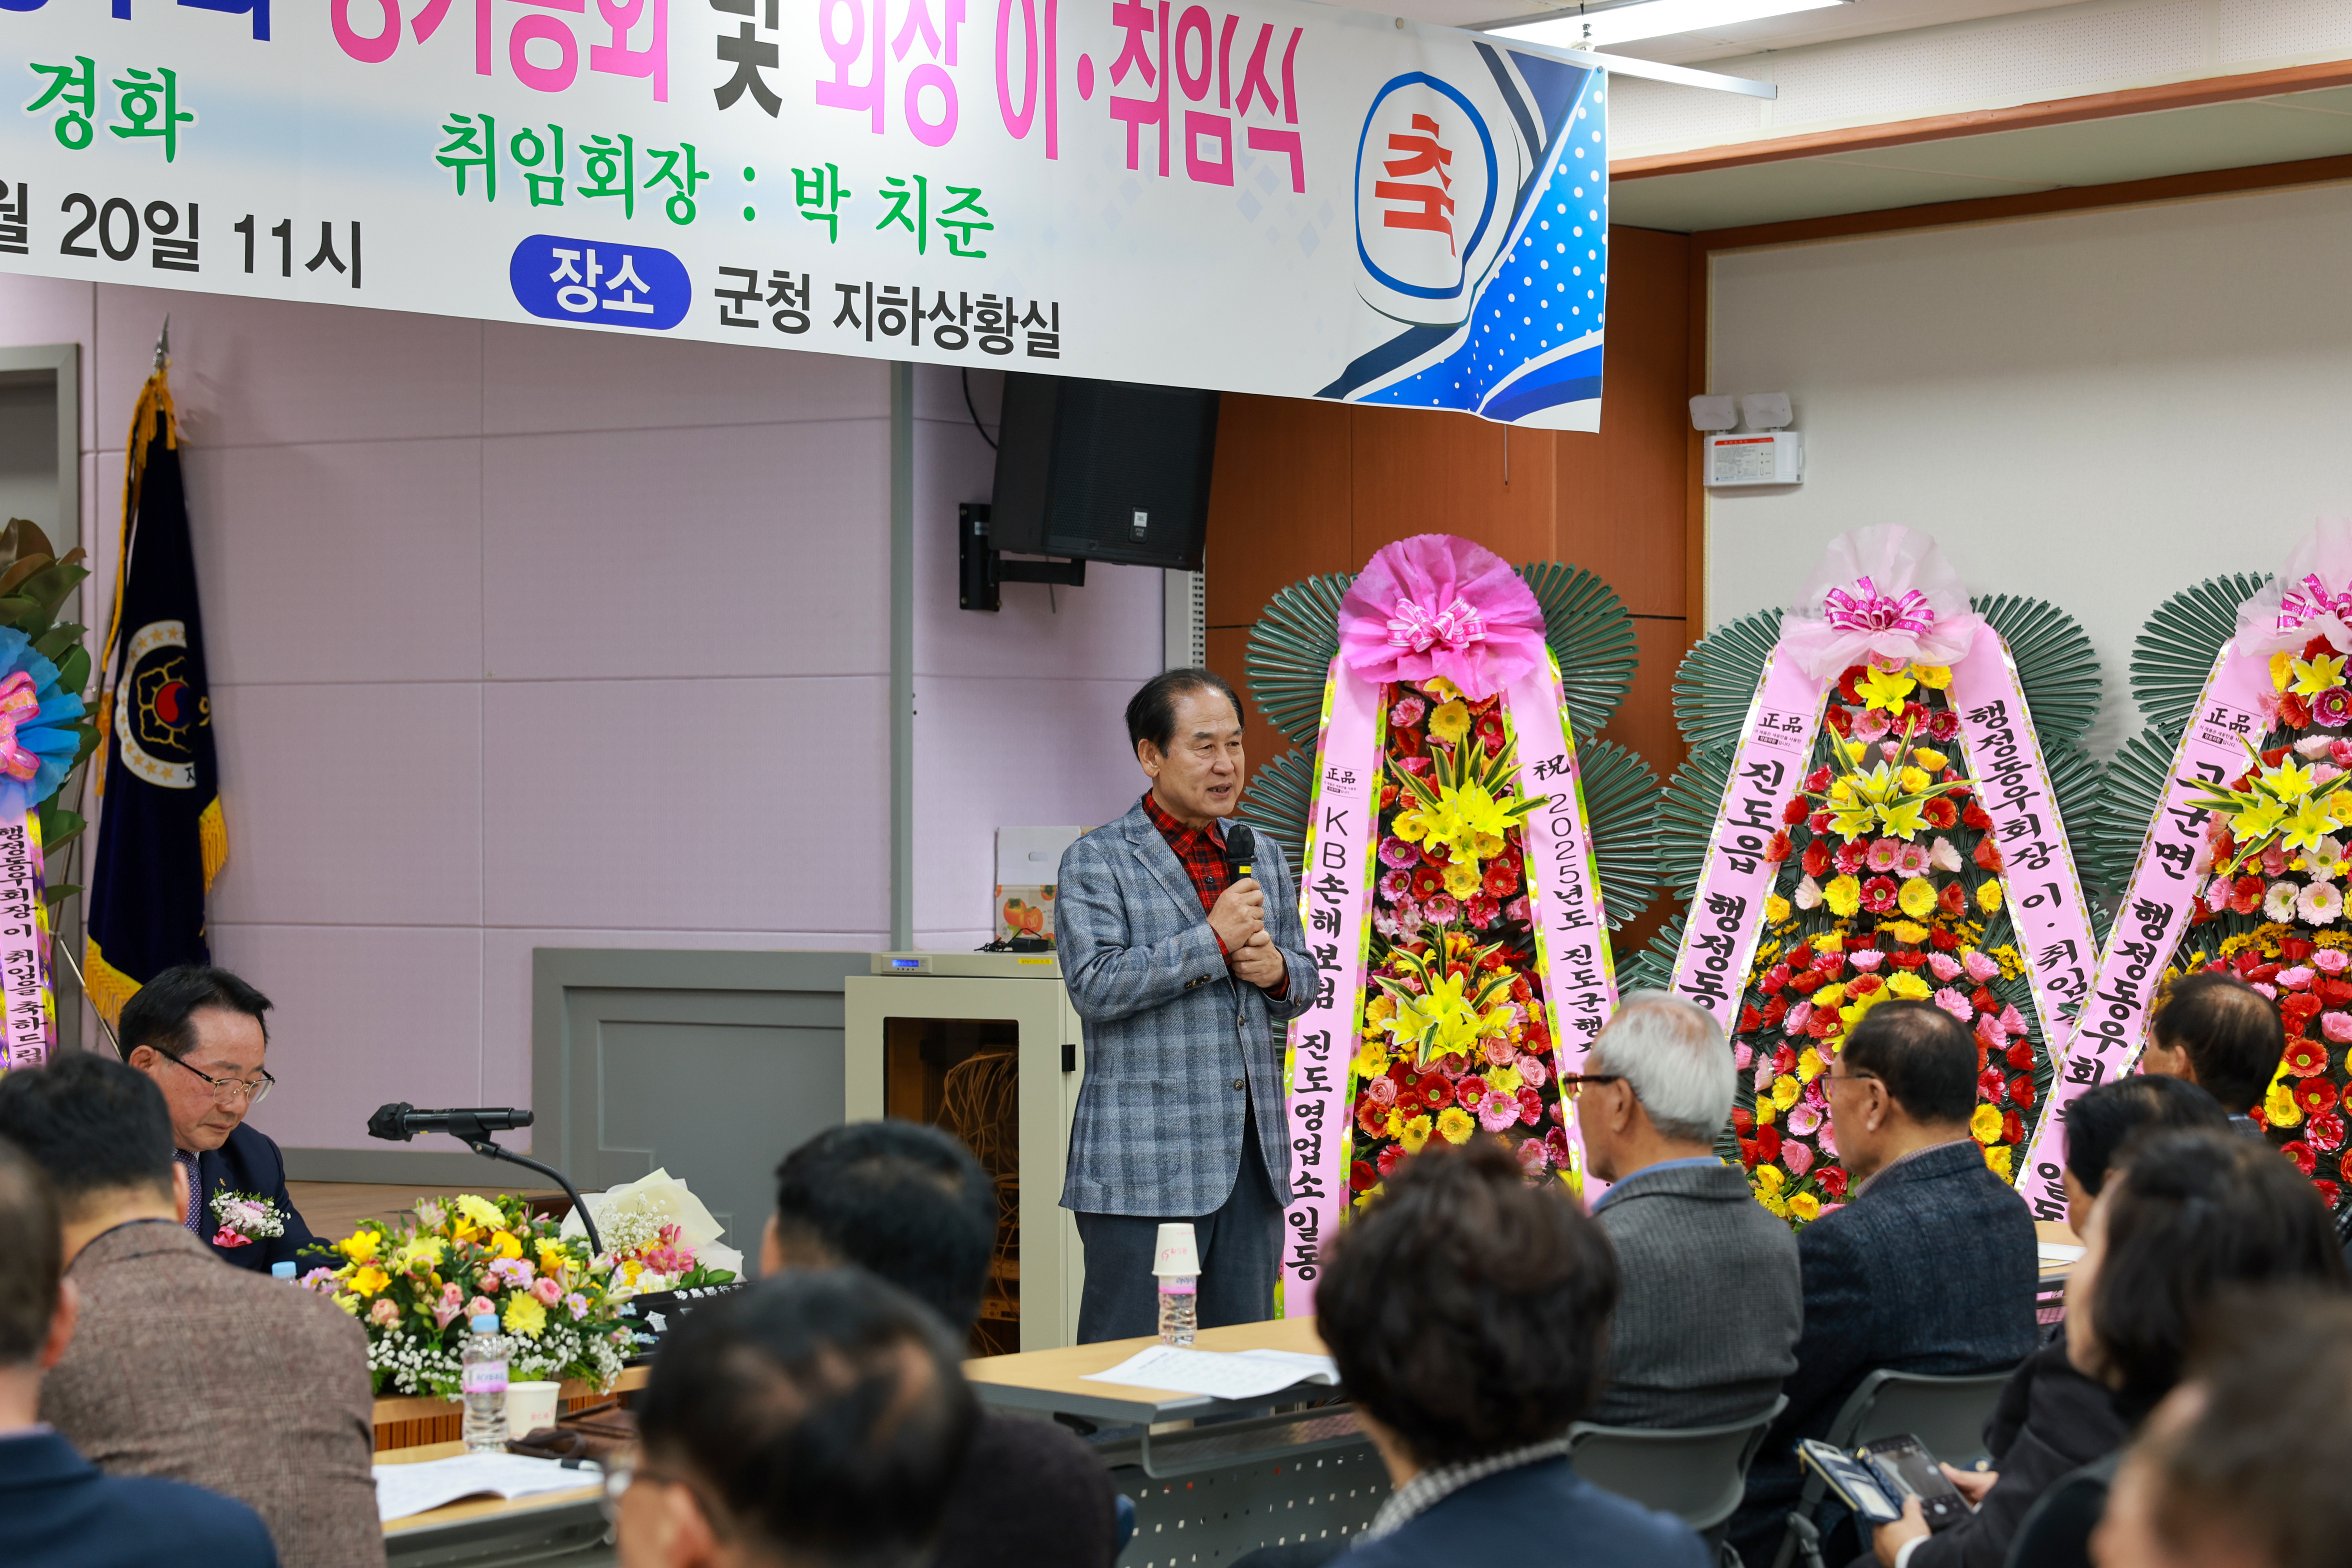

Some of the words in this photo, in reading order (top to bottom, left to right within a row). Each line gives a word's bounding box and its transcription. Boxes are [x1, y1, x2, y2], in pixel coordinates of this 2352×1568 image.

[27, 56, 194, 163] 경화
[436, 113, 709, 225] 취임회장
[791, 163, 851, 244] 박
[877, 175, 994, 258] 치준
[1375, 113, 1456, 257] 축
[60, 193, 199, 272] 20일
[234, 214, 361, 289] 11시
[551, 249, 655, 315] 장소
[715, 266, 810, 334] 군청
[833, 282, 1060, 358] 지하상황실
[1532, 755, 1571, 781] 祝
[1758, 713, 1803, 733] 正品
[2204, 708, 2250, 733] 正品
[1325, 768, 1356, 784] 正品
[1719, 760, 1785, 875] 진도읍
[1964, 700, 2059, 870] 행정동우회장
[1310, 807, 1349, 1009] KB손해보험
[1549, 793, 1594, 931] 2025년도
[4, 924, 32, 938] 이
[2054, 897, 2173, 1122] 행정동우회
